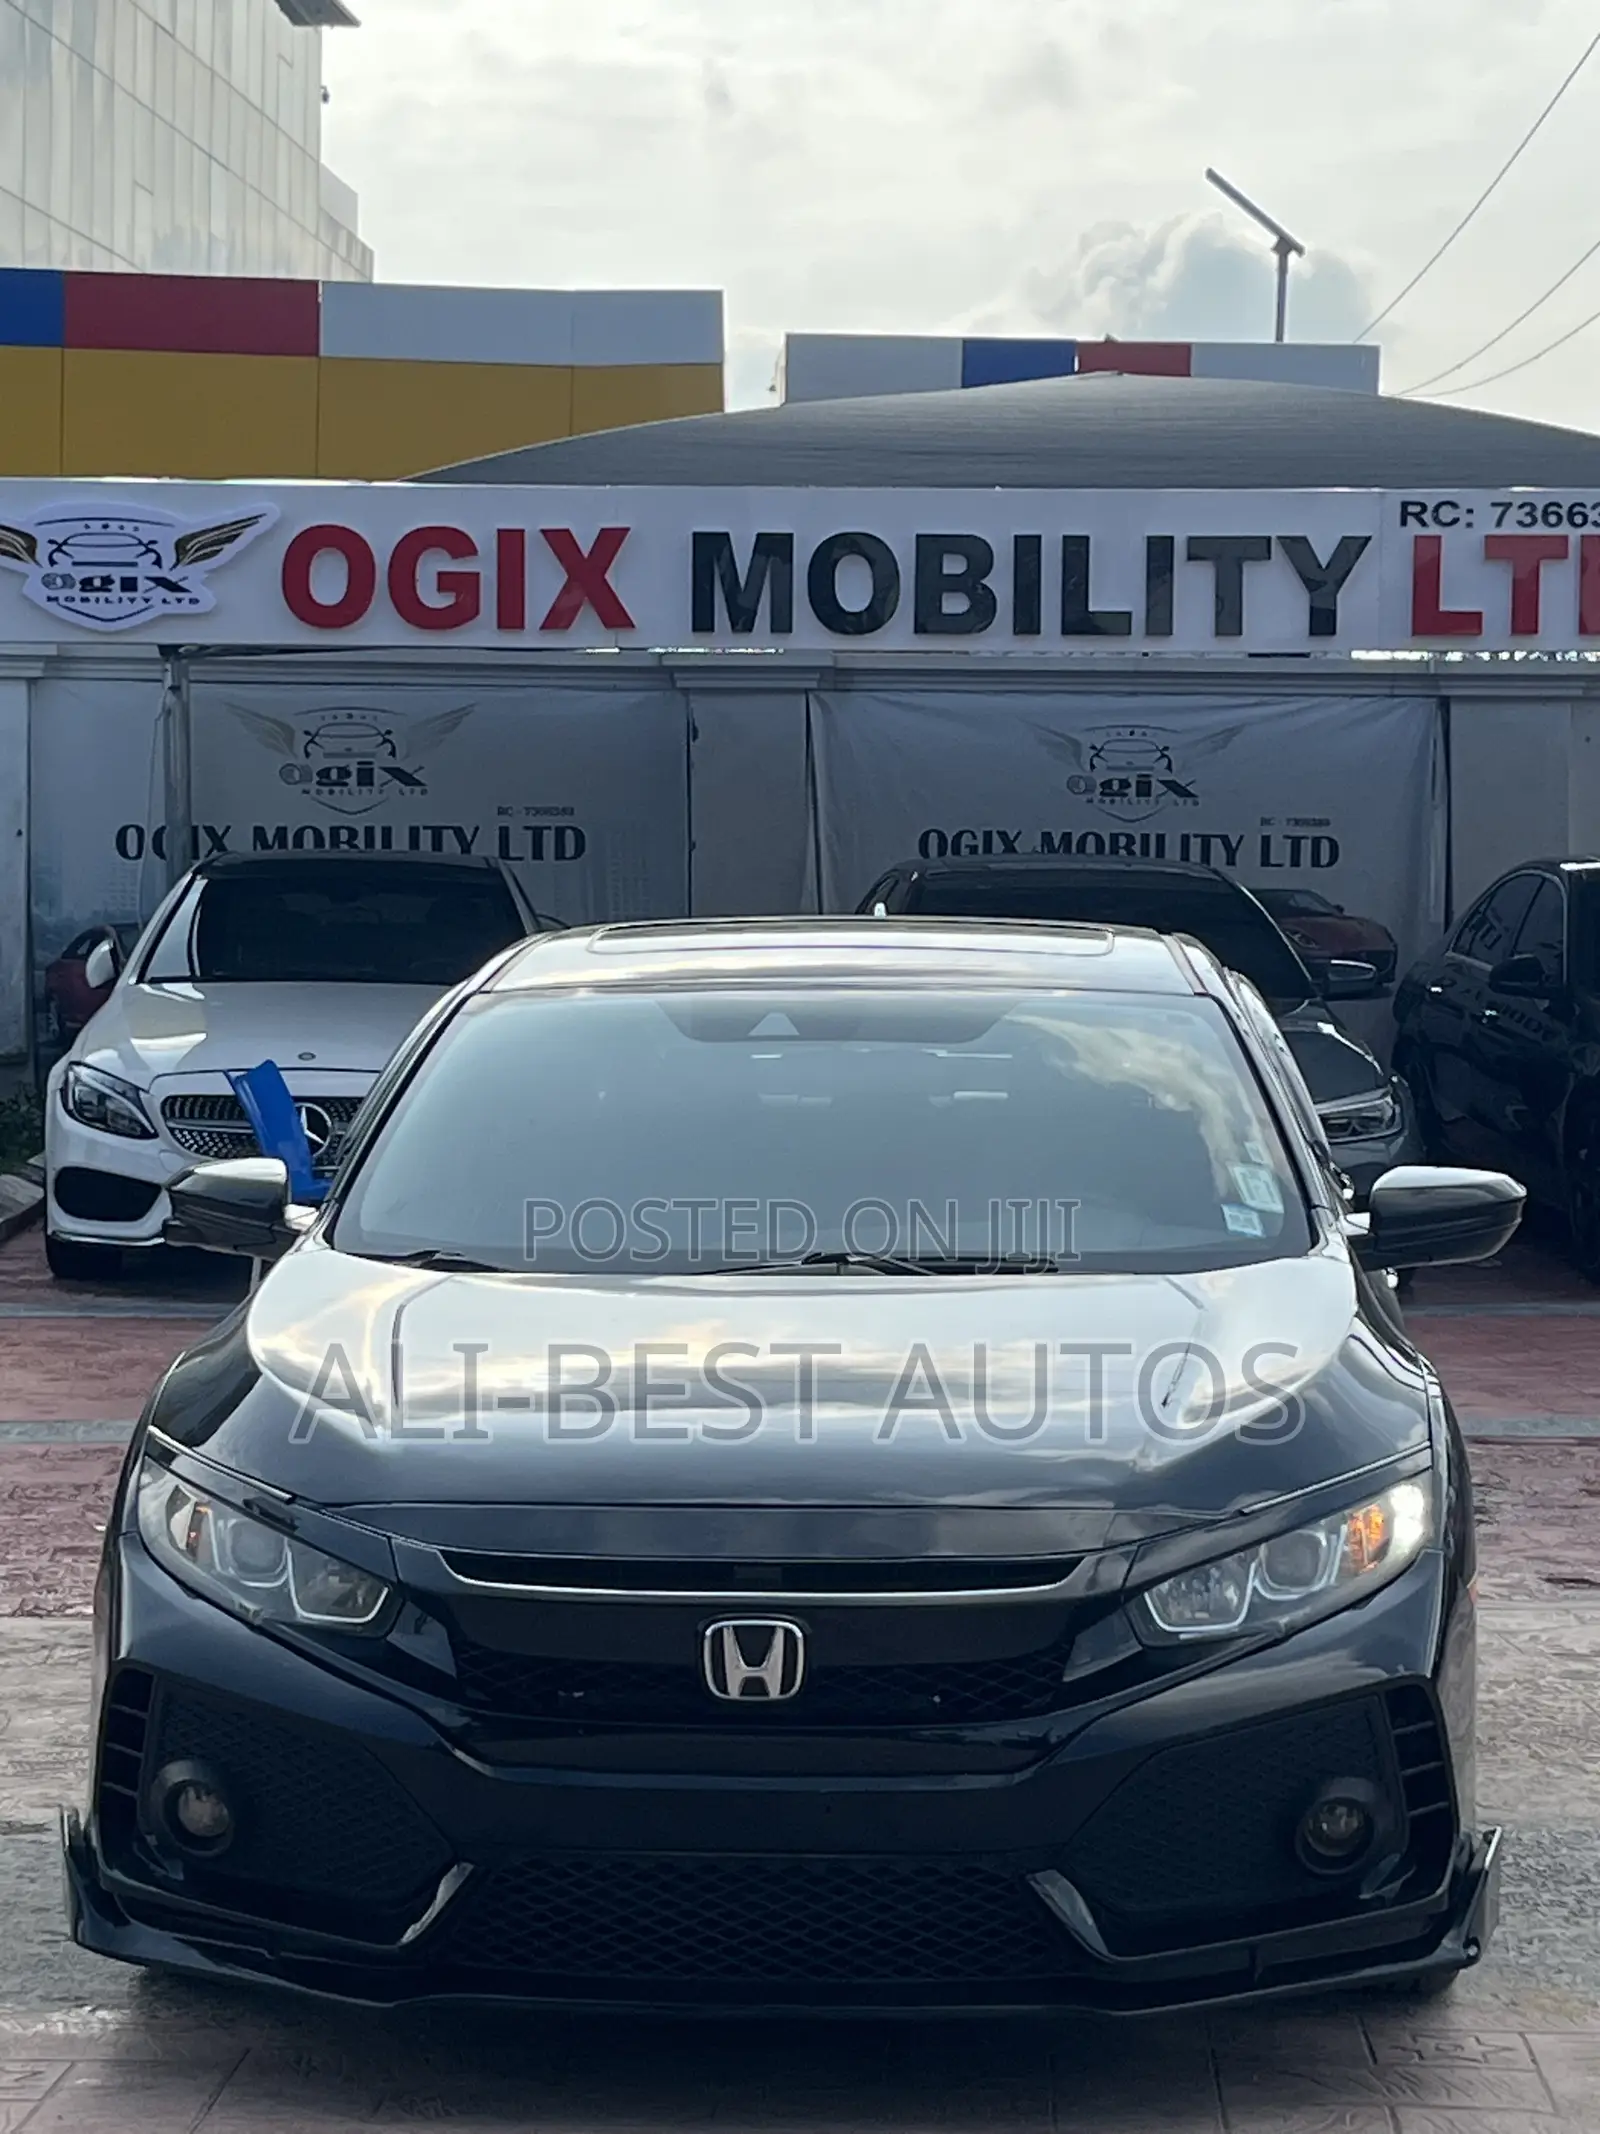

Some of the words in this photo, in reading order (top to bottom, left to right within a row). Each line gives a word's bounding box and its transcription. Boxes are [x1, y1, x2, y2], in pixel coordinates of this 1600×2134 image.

[1400, 499, 1475, 529] RC:
[280, 523, 636, 631] OGIX
[691, 529, 1372, 637] MOBILITY
[1411, 533, 1600, 637] LT
[161, 596, 201, 605] LTD
[497, 825, 586, 861] LTD
[918, 828, 1022, 859] OGIX
[1259, 834, 1340, 868] LTD
